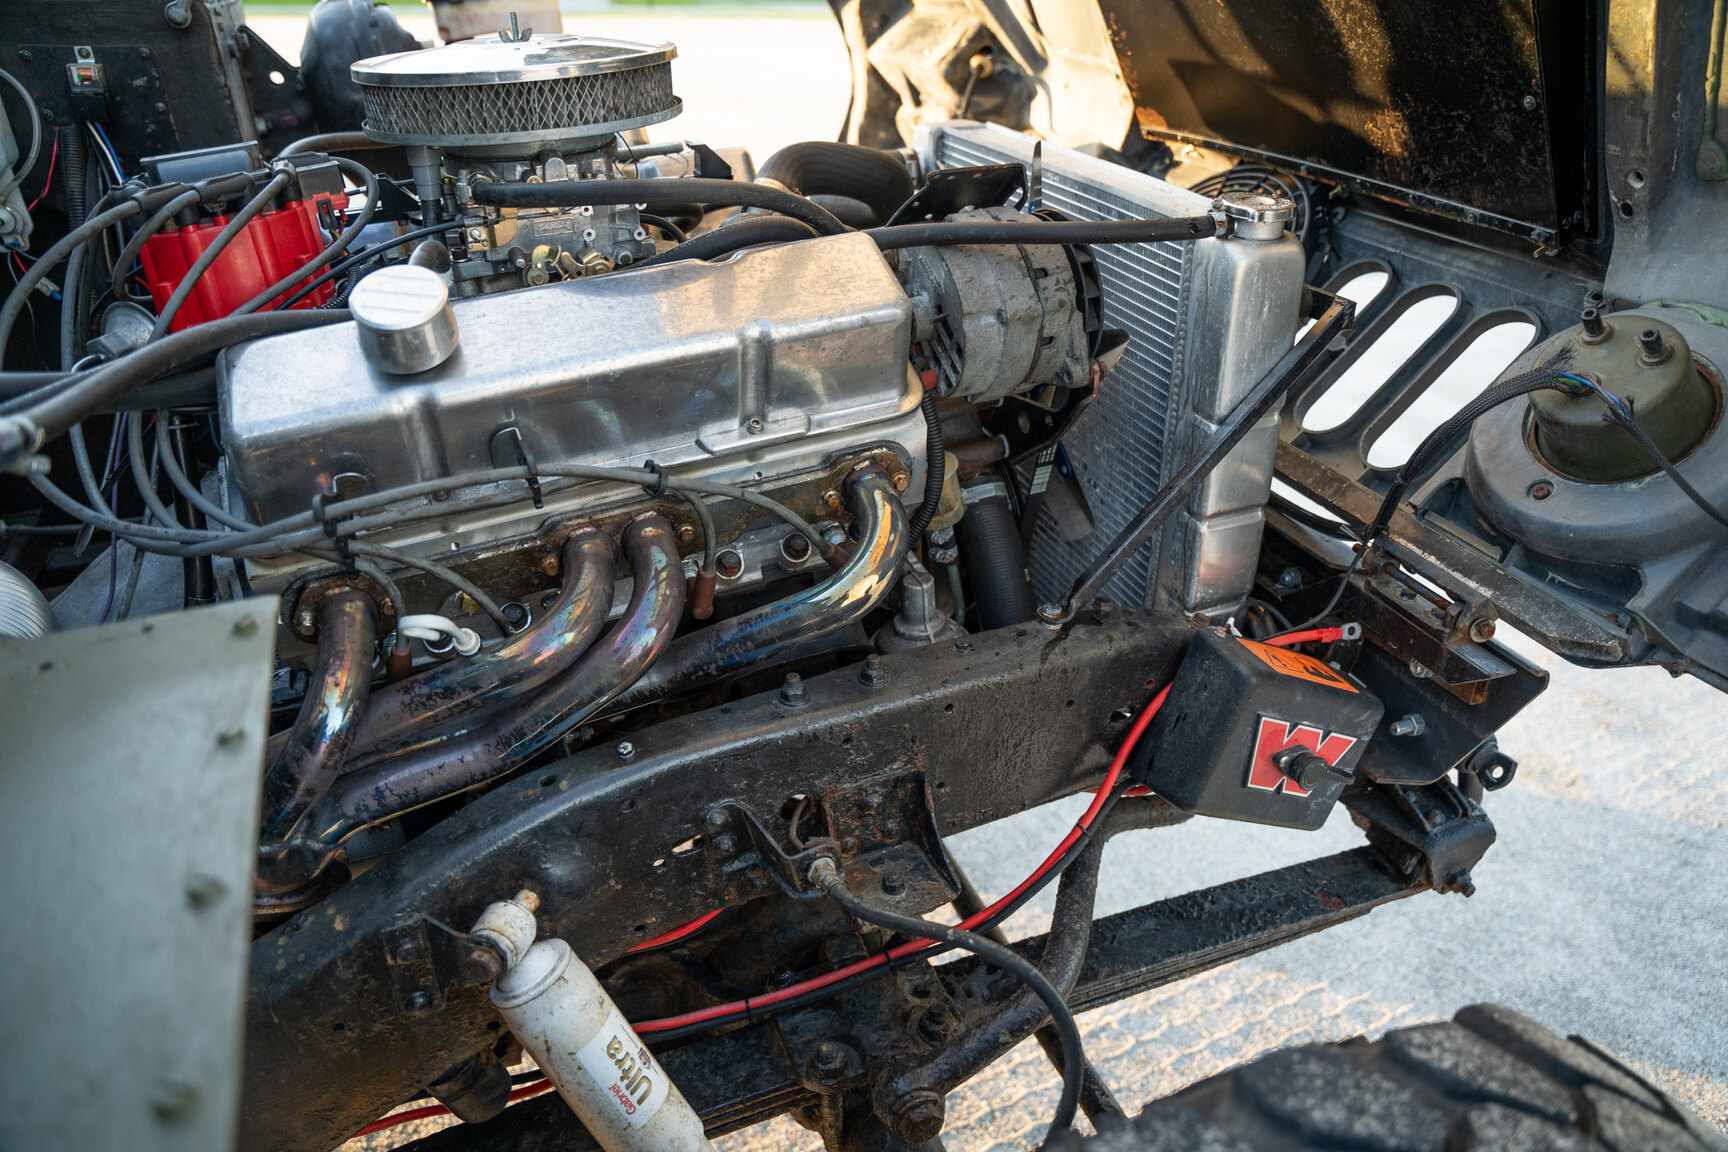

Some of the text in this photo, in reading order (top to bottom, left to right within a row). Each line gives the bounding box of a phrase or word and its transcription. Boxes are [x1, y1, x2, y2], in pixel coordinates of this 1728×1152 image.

[1246, 715, 1358, 798] W
[606, 1035, 652, 1106] Ultra
[608, 1083, 637, 1115] Gabriel
